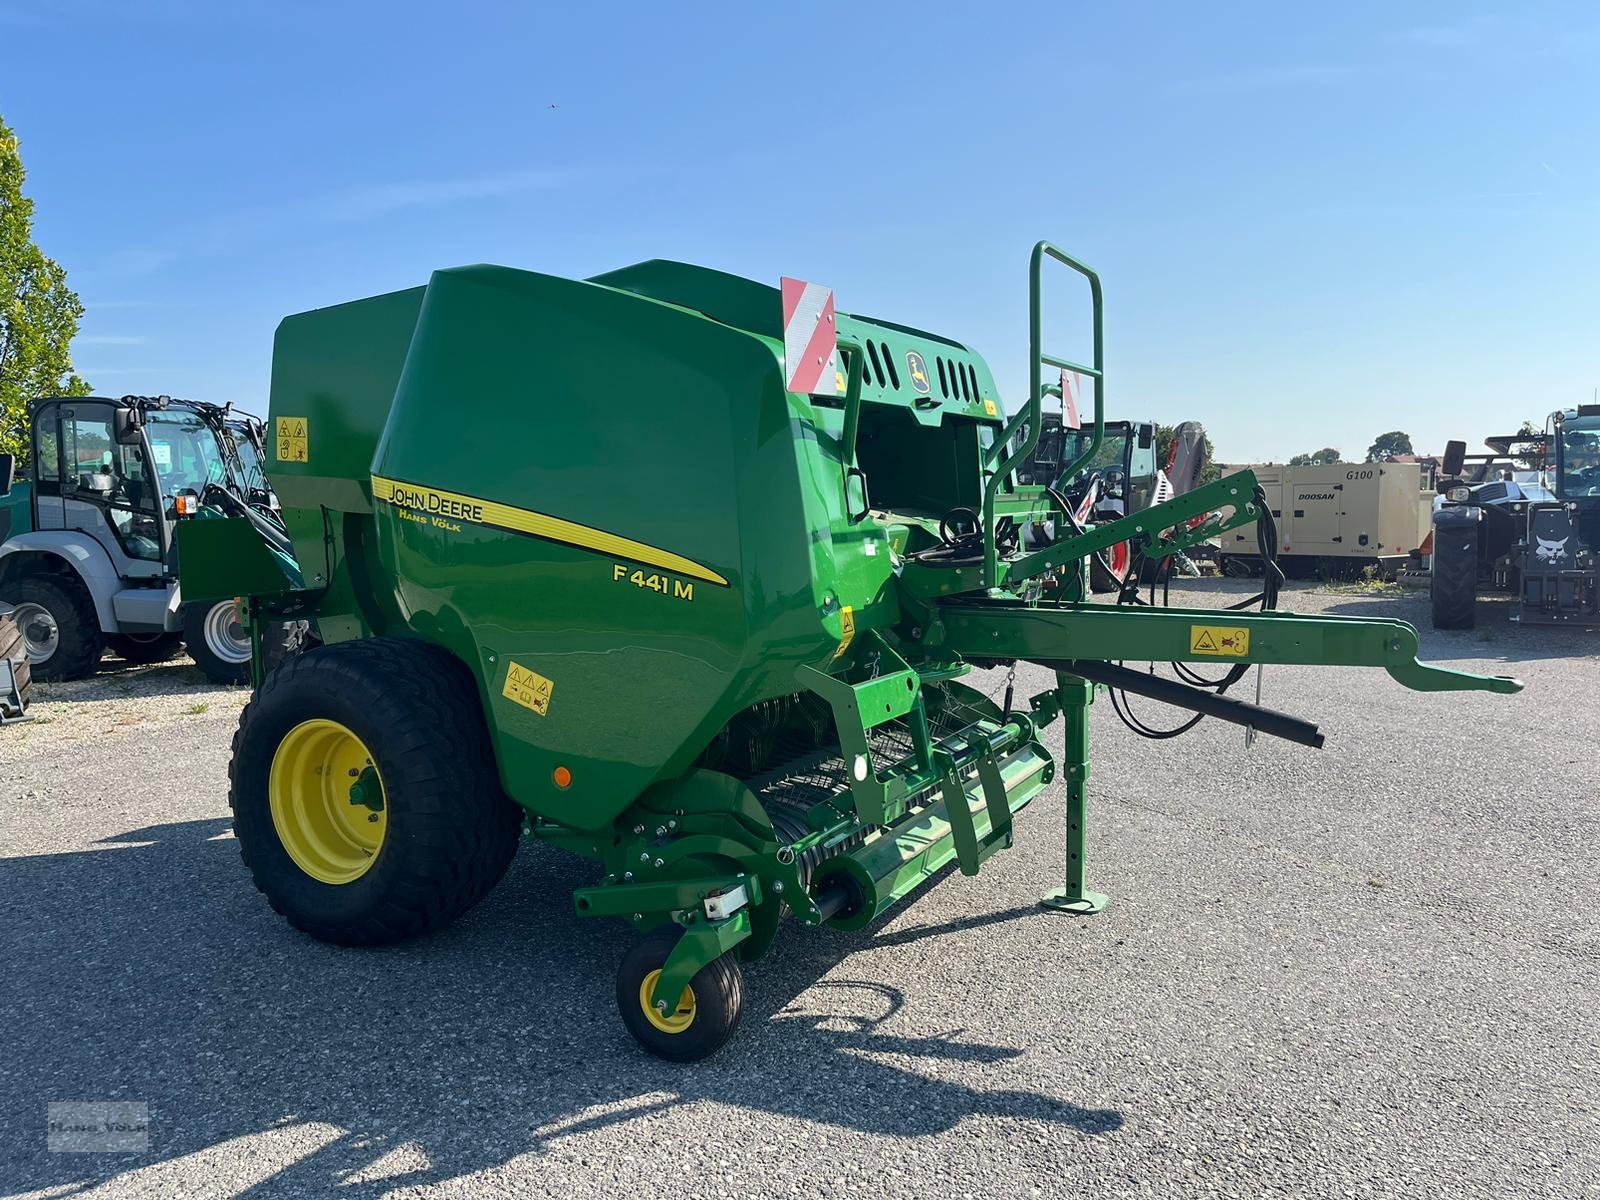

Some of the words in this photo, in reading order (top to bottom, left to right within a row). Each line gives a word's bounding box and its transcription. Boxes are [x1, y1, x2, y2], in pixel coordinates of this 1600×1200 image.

[1346, 470, 1373, 480] G100
[388, 484, 425, 509] JOHN
[428, 493, 483, 521] DEERE
[613, 564, 628, 581] F
[630, 570, 669, 594] 441
[674, 579, 694, 601] M
